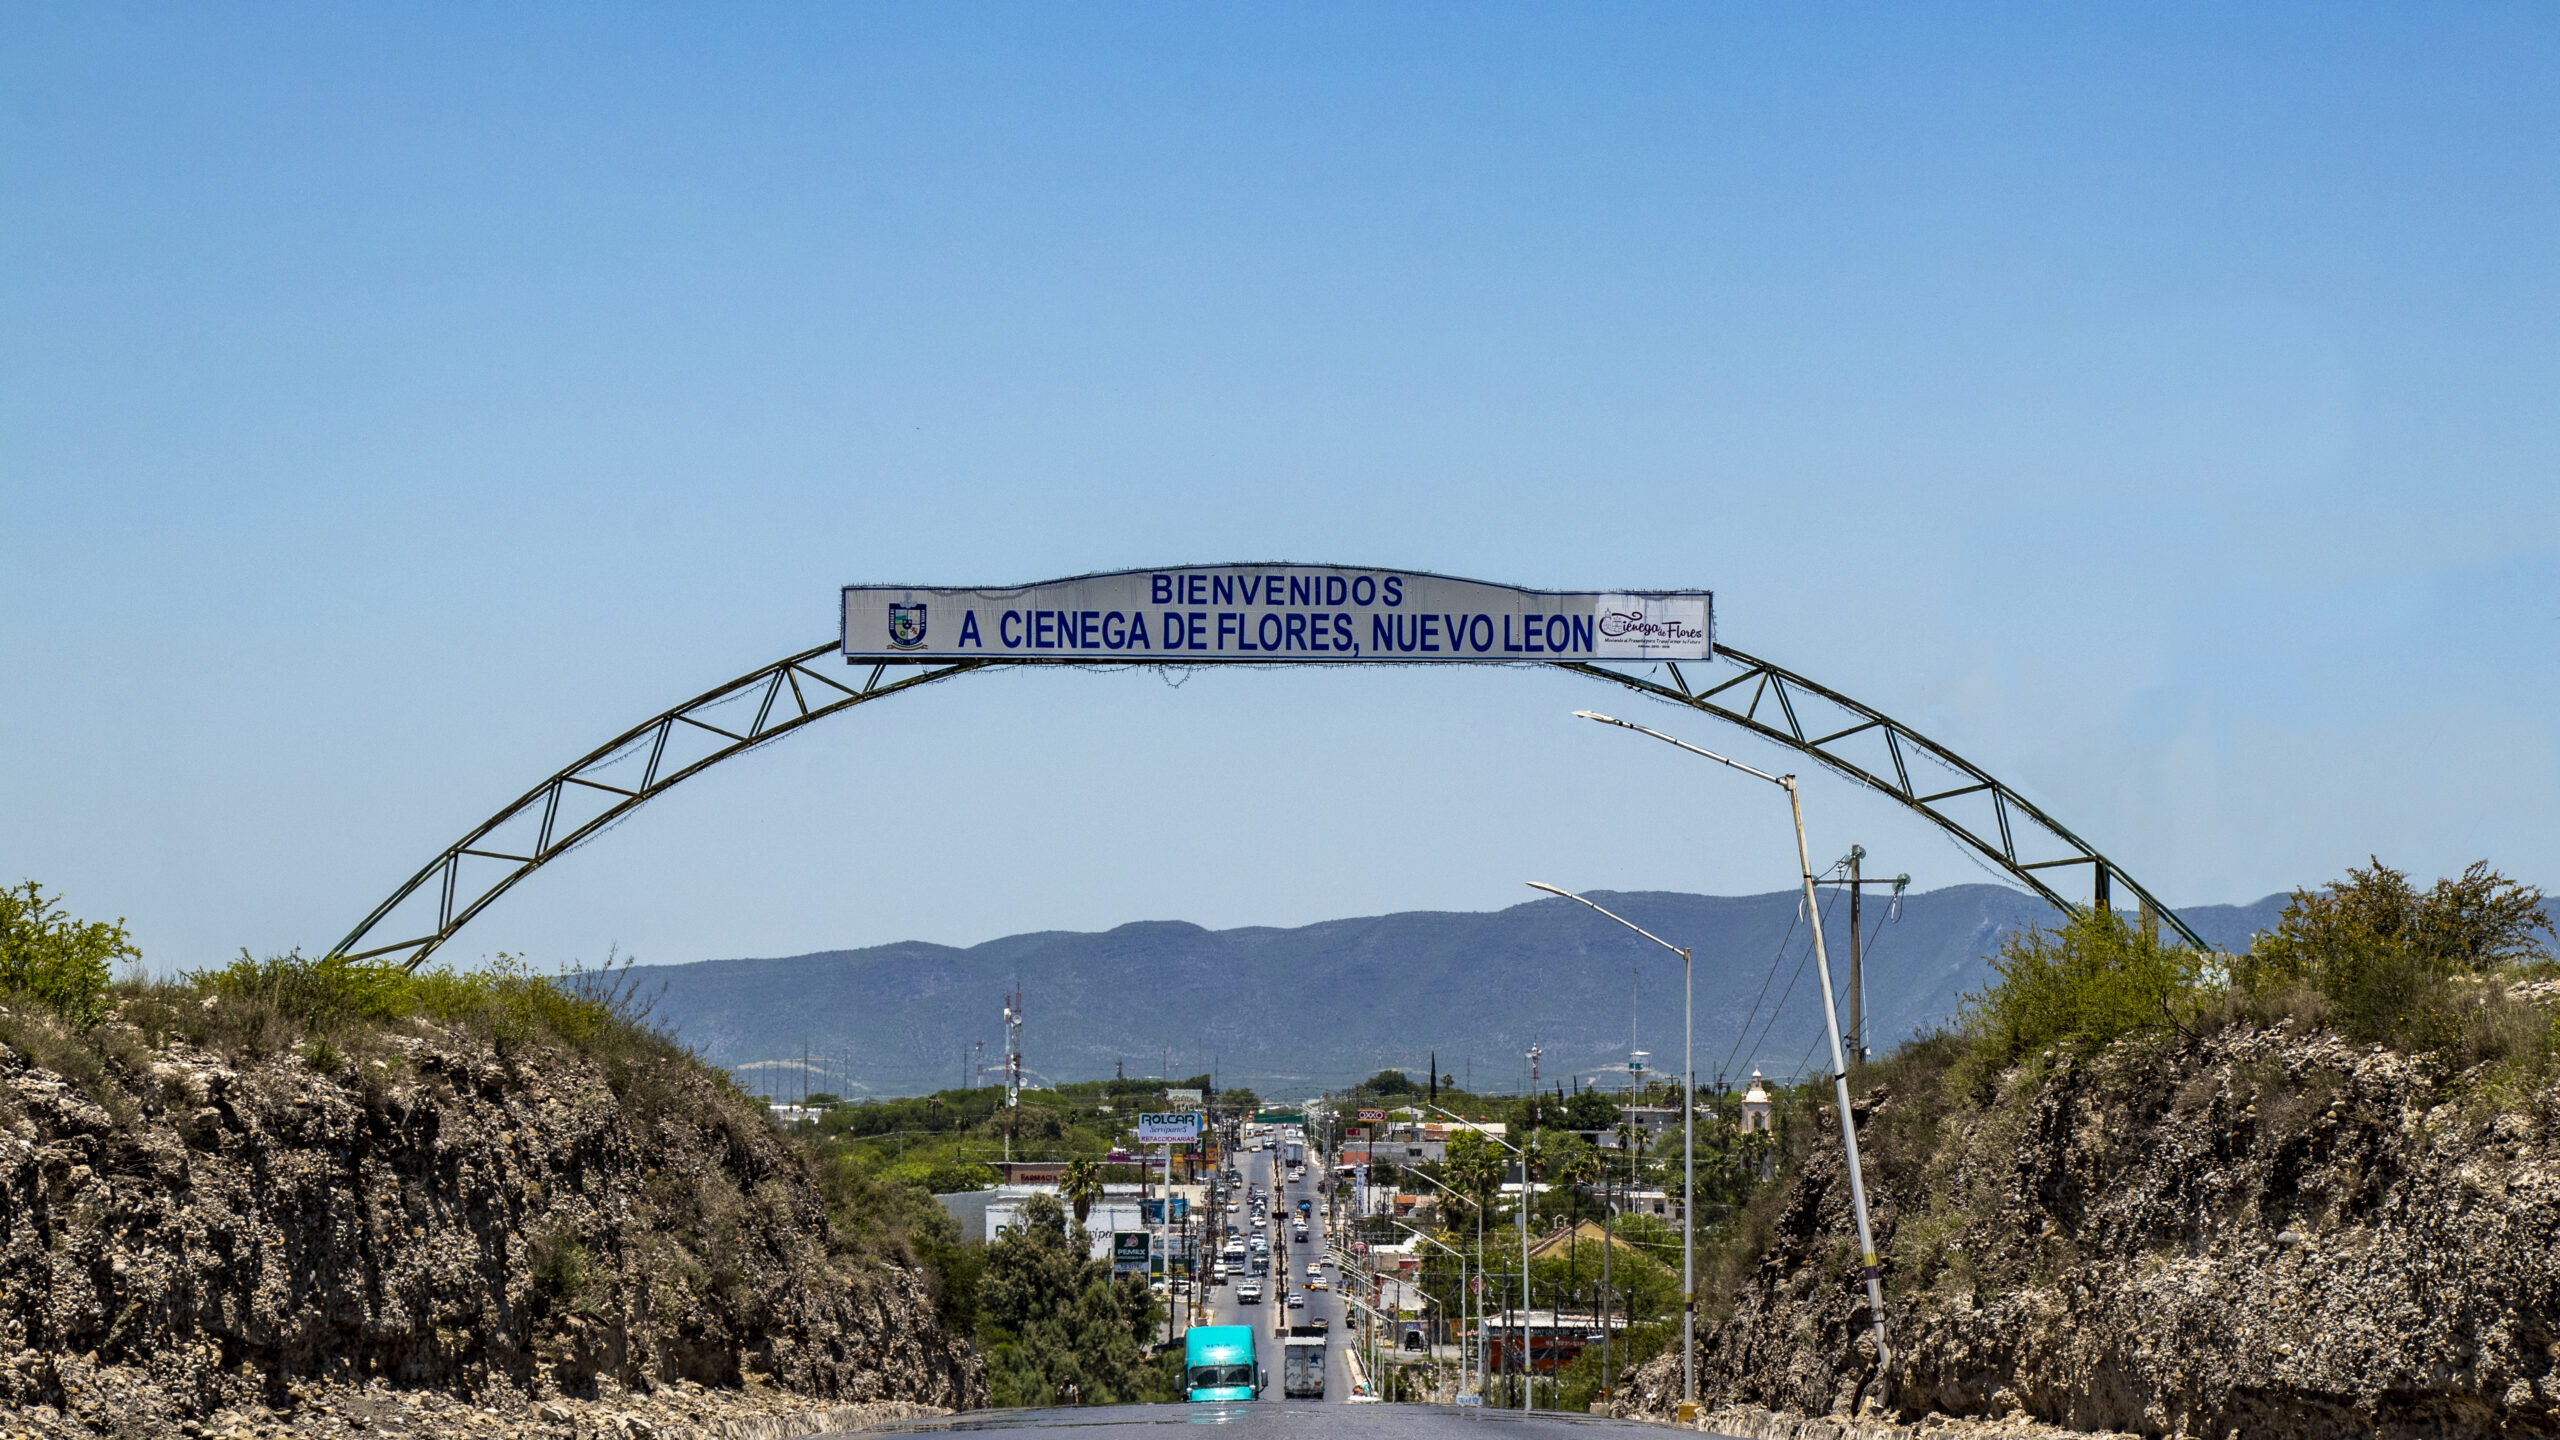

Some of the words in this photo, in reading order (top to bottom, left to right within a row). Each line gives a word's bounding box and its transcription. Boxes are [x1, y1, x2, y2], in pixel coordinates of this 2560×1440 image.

[1151, 574, 1403, 606] BIENVENIDOS
[958, 609, 983, 648] A
[1000, 609, 1151, 650] CIENEGA
[1163, 611, 1208, 651] DE
[1217, 612, 1360, 657] FLORES,
[1372, 613, 1495, 653] NUEVO
[1503, 614, 1594, 653] LEON
[1658, 626, 1667, 637] de
[1661, 621, 1702, 639] Flores
[1141, 1114, 1195, 1126] ROLCAR
[1359, 1111, 1383, 1119] OXXO
[1117, 1248, 1146, 1256] PEMEX
